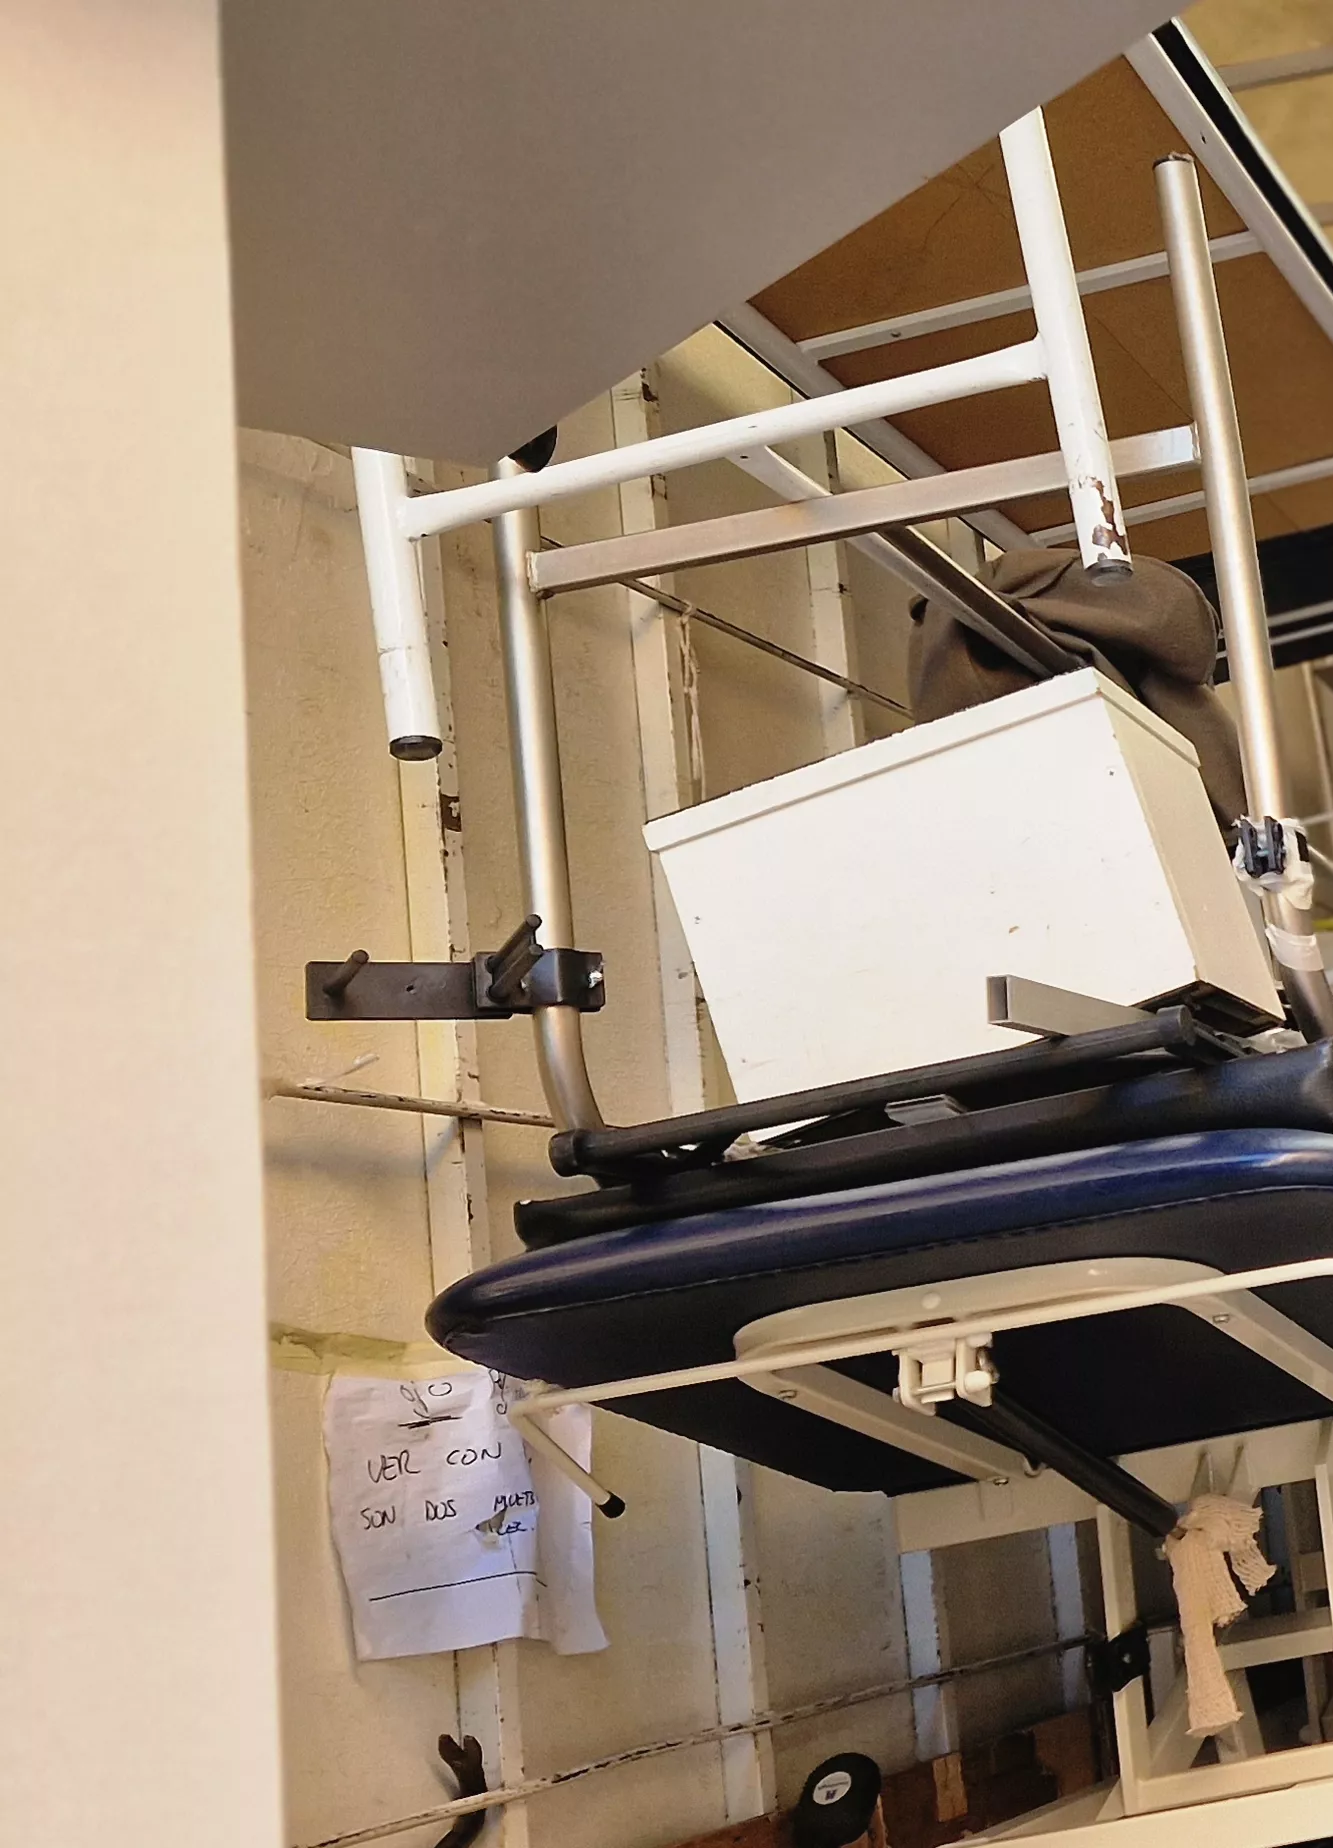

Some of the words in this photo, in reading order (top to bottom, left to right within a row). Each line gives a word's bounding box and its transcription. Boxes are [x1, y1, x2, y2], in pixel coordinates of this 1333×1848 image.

[367, 1450, 421, 1484] VER
[446, 1442, 502, 1466] CON
[360, 1505, 397, 1530] SON
[425, 1499, 457, 1521] DOS
